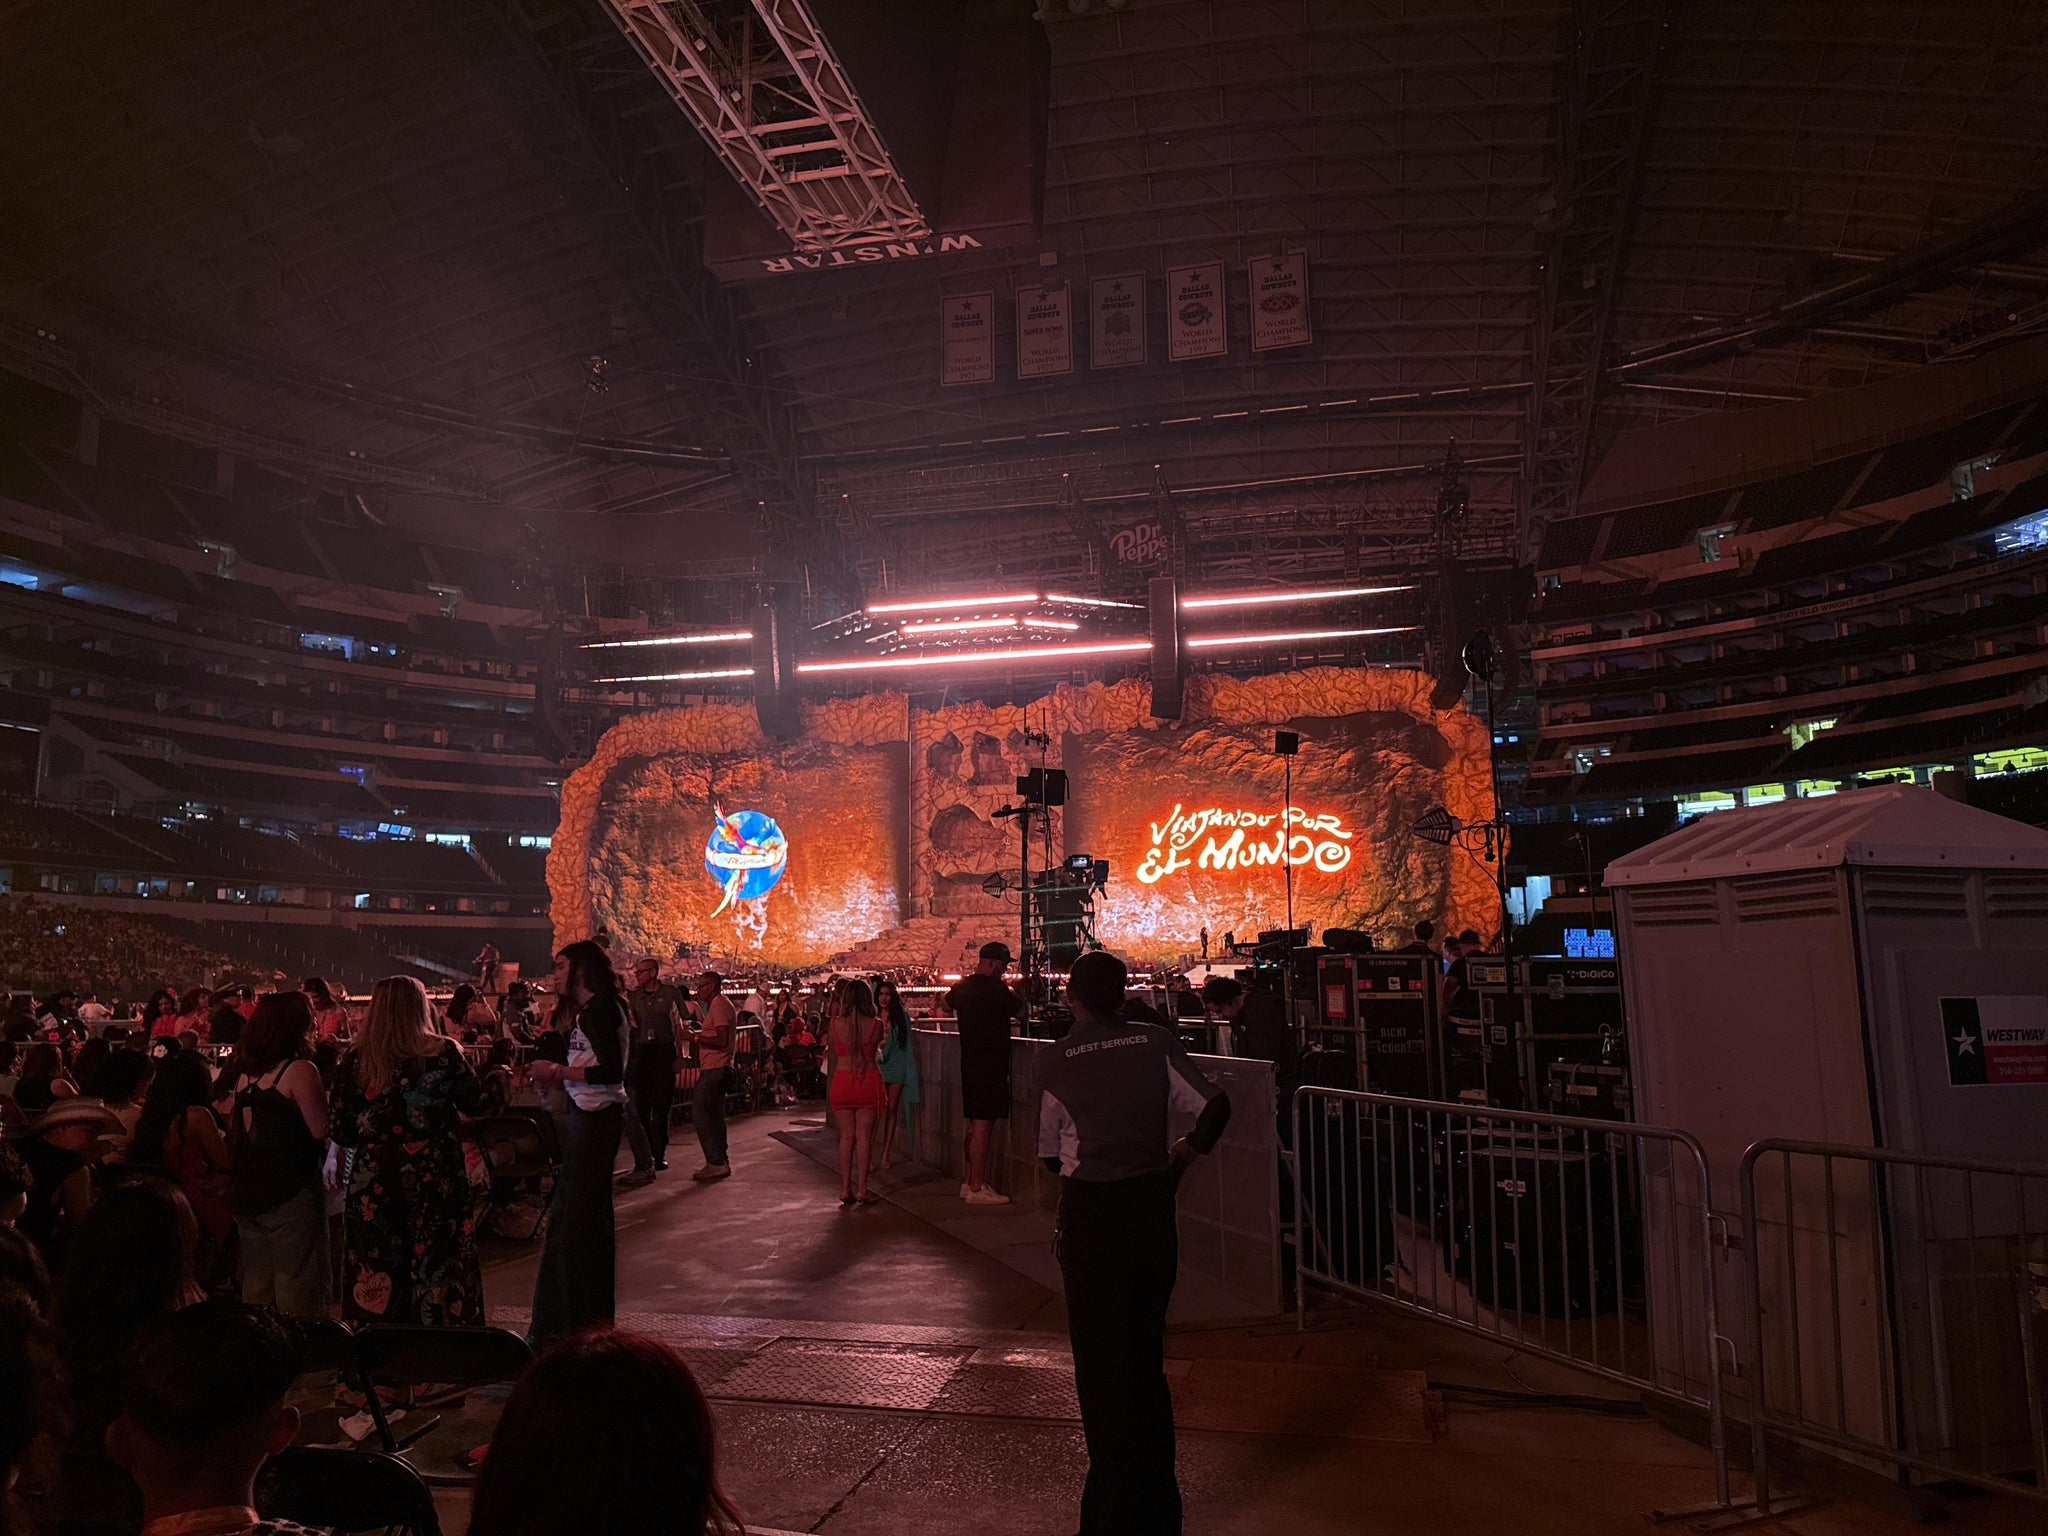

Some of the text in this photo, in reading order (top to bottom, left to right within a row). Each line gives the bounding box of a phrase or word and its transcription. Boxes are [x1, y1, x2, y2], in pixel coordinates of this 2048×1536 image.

[1263, 273, 1293, 283] DALLAS
[1182, 284, 1210, 293] DALLAS
[1261, 280, 1297, 291] COWBOYS
[1104, 294, 1132, 303] DALLAS
[1178, 291, 1214, 301] COWBOYS
[1030, 304, 1057, 313] DALLAS
[1101, 301, 1135, 311] COWBOYS
[954, 312, 981, 321] DALLAS
[1027, 311, 1061, 320] COWBOYS
[951, 320, 984, 328] COWBOYS
[1265, 318, 1297, 327] WORLD
[1182, 329, 1213, 338] WORLD
[1257, 325, 1307, 338] CHAMPIONS
[1173, 336, 1222, 347] CHAMPIONS
[1030, 347, 1060, 356] WORLD
[953, 356, 982, 365] WORLD
[1022, 355, 1069, 365] CHAMPIONS
[945, 363, 991, 374] CHAMPIONS
[1136, 524, 1161, 544] Dr
[1109, 530, 1168, 564] Peppe
[1780, 606, 1818, 620] RAYFIELD
[1820, 599, 1854, 611] WRIGHT
[1136, 828, 1351, 884] EL MUNDO
[1987, 1028, 2046, 1041] WESTWAY
[1065, 1035, 1149, 1058] GUEST SERVICES
